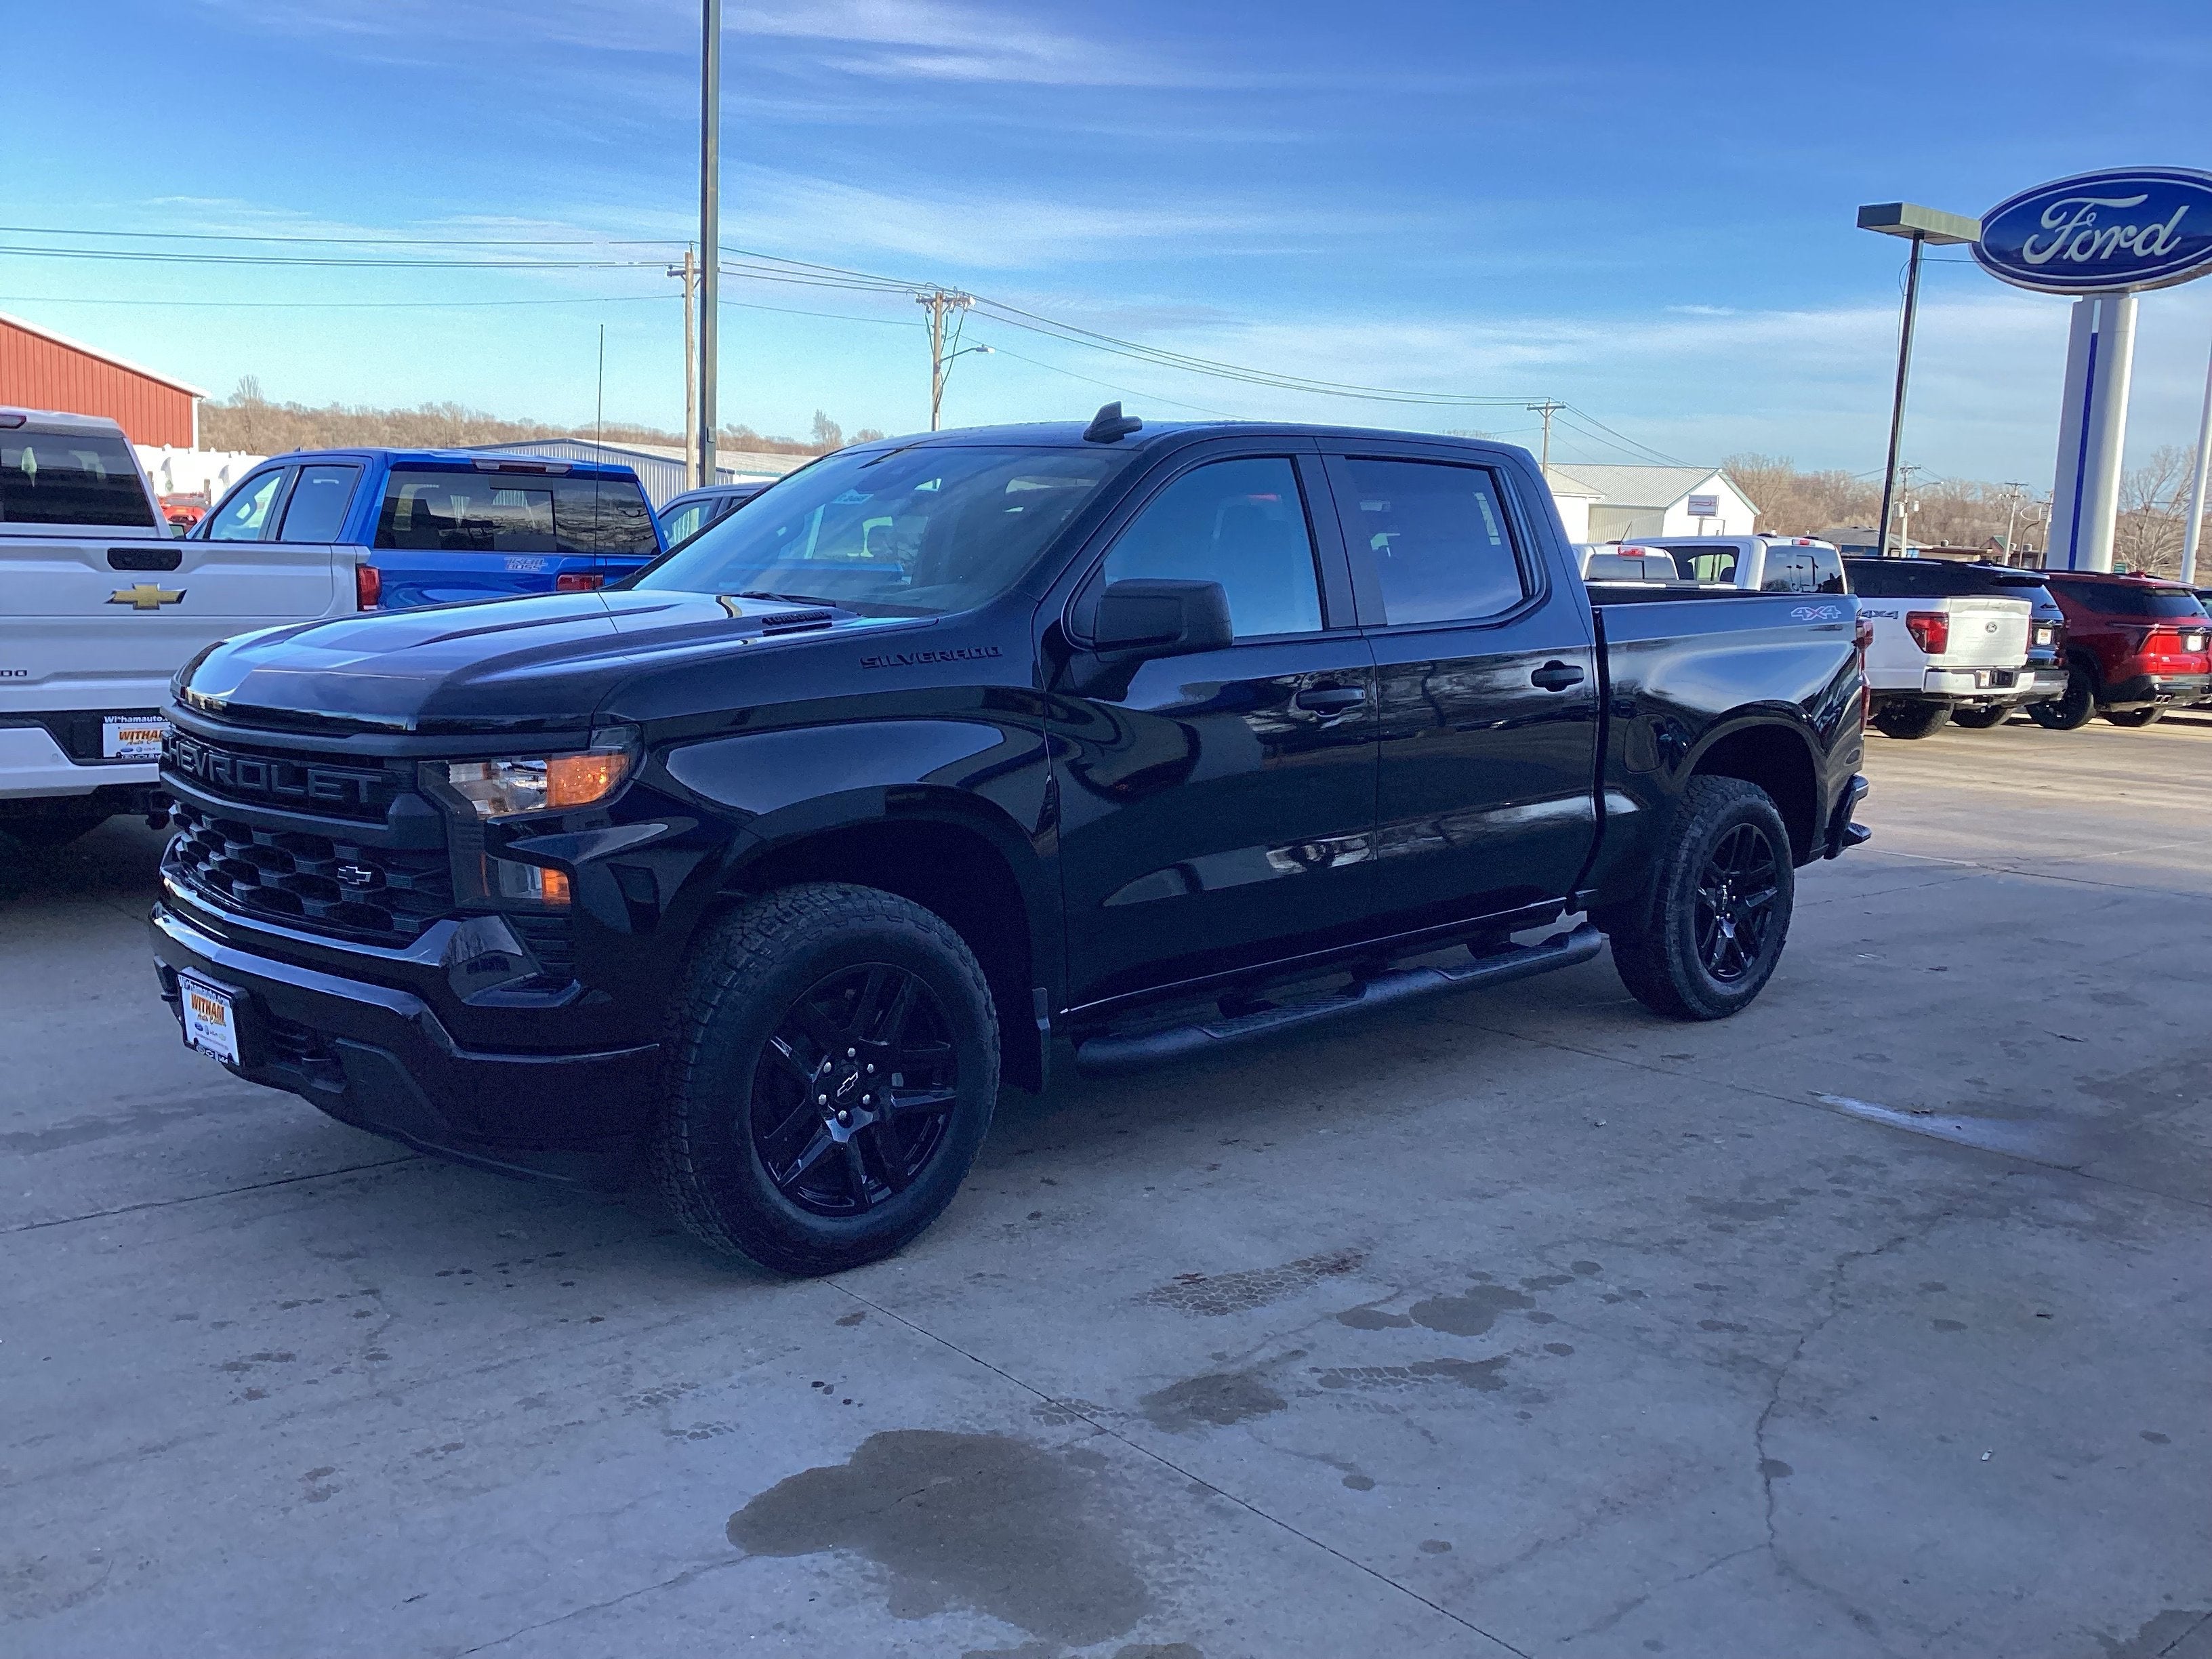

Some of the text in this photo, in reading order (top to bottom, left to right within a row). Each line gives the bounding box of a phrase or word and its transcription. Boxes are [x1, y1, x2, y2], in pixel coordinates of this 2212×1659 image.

[2022, 194, 2190, 265] Ford
[859, 646, 1003, 669] SILVERADO
[191, 994, 224, 1023] WITHAM
